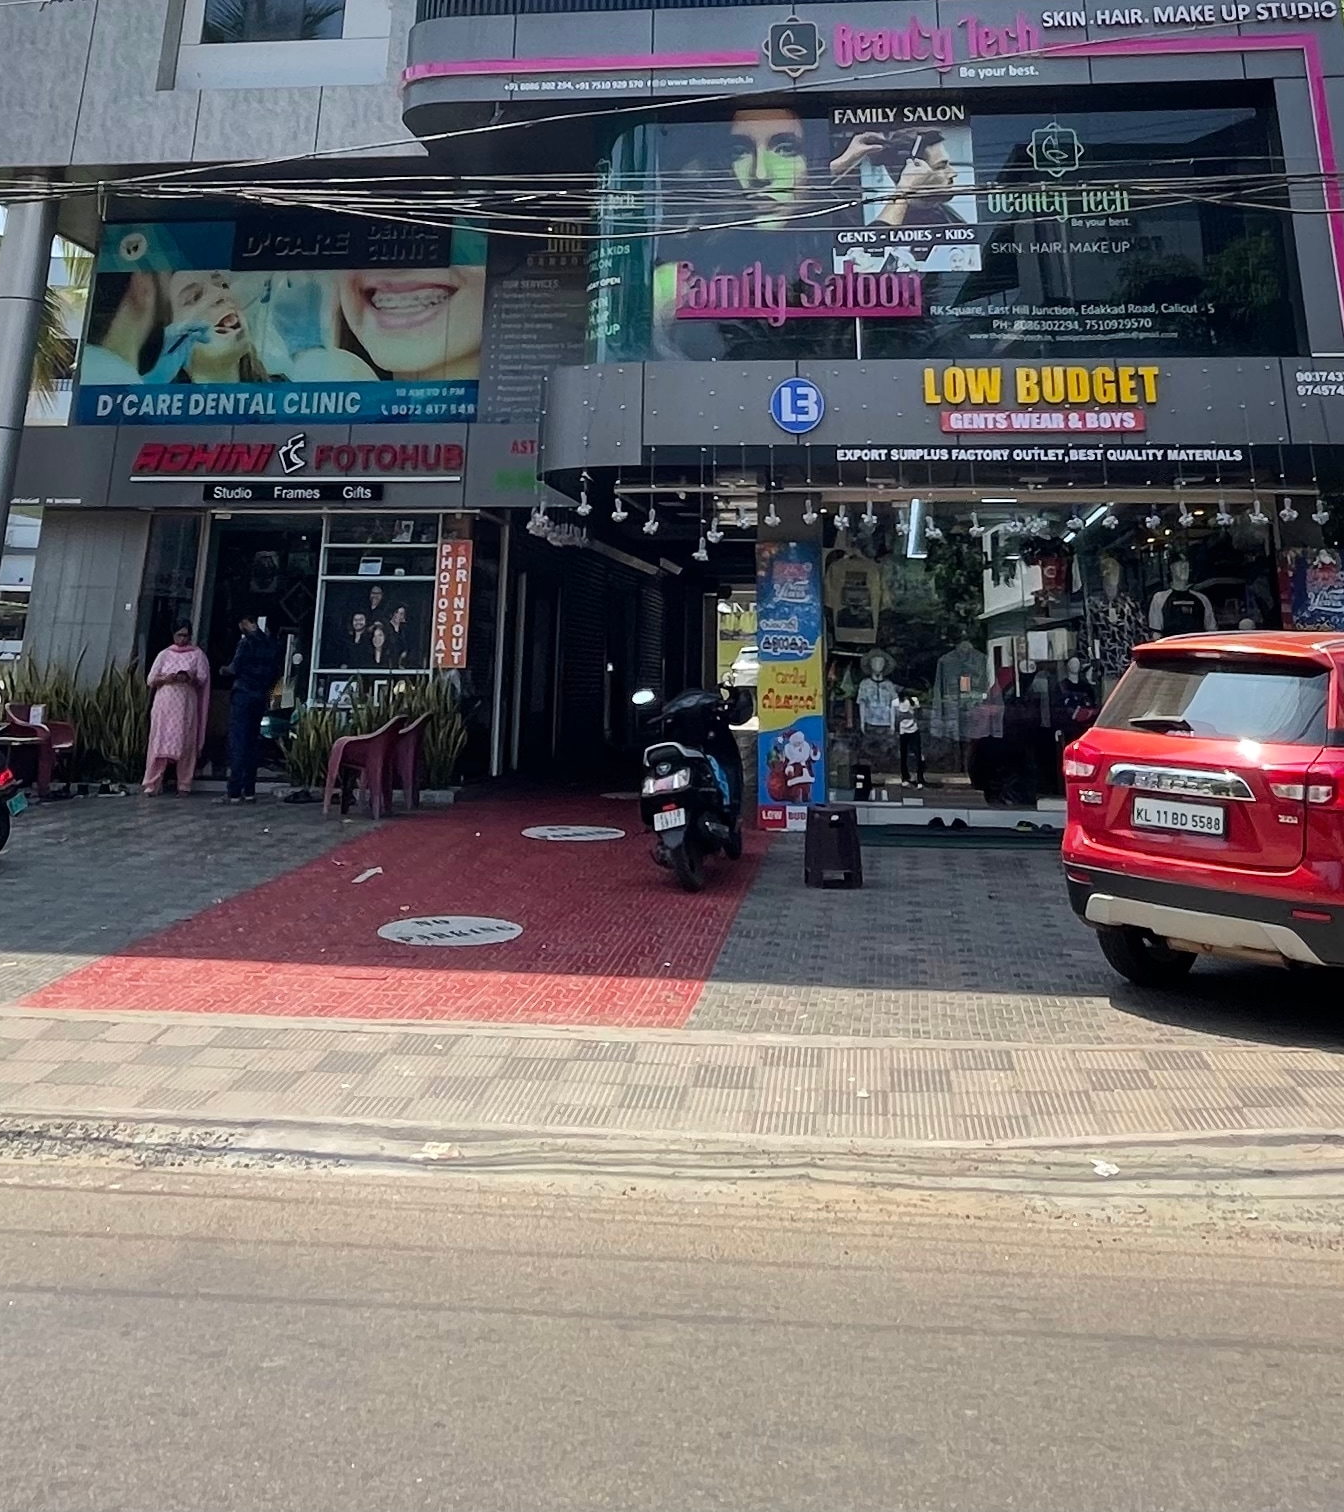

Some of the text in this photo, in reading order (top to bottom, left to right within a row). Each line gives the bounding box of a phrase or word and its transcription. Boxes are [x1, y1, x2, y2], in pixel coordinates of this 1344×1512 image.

[1154, 4, 1216, 23] MAKE
[1220, 3, 1251, 21] UP
[1256, 0, 1338, 20] STUDIO
[833, 10, 1041, 73] Beauty Tech
[959, 65, 1040, 80] Be your best.
[834, 105, 965, 124] FAMILY SALON
[1084, 219, 1107, 229] your
[837, 228, 975, 243] GENTS LADIES KIDS
[606, 244, 631, 257] KIDS
[1069, 241, 1111, 254] MAKE
[1112, 241, 1131, 253] UP
[676, 259, 922, 327] Family Saloon
[930, 306, 945, 315] RK
[988, 305, 1010, 315] East
[1011, 305, 1030, 315] Hill
[1081, 303, 1126, 315] Edakkad
[1160, 303, 1198, 314] Calicut
[1084, 318, 1153, 331] 7510929570
[922, 366, 1159, 404] LOW BUDGET
[96, 391, 362, 418] D'CARE DENTAL CLINIC
[950, 411, 1135, 429] GENTS WEAR & BOYS
[131, 443, 464, 474] ROHINI FOTOHUB
[836, 449, 888, 462] EXPORT
[890, 448, 948, 461] SURPLUS
[951, 448, 1009, 461] FACTORY
[1107, 448, 1164, 461] QUALITY
[1167, 448, 1243, 462] MATERIALS
[212, 485, 372, 500] Studio Frames Gifts
[435, 544, 452, 664] PHOTOSTAT
[451, 556, 467, 664] PRINTOUT
[1136, 807, 1221, 831] KL 11 BD 5588
[397, 925, 516, 941] PARKING
